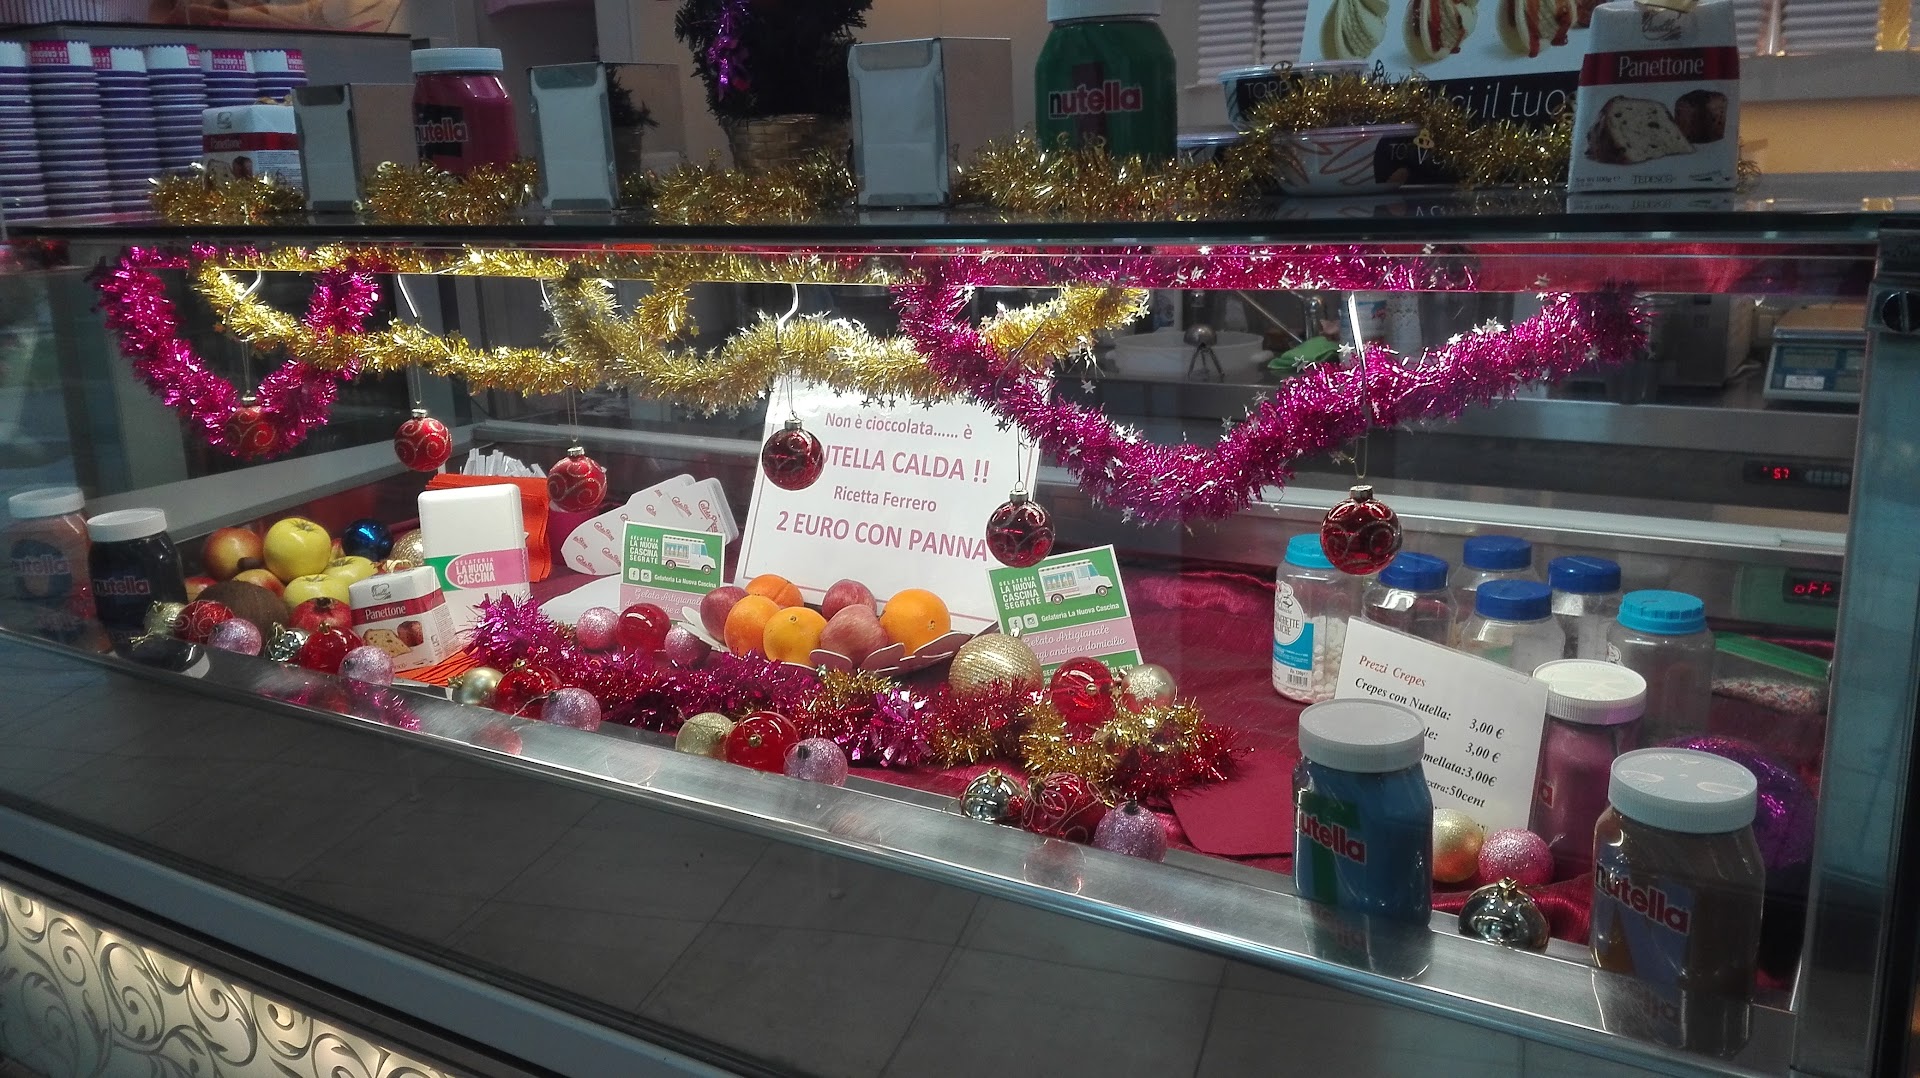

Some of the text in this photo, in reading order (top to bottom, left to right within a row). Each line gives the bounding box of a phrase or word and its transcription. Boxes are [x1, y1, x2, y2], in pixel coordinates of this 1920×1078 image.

[1618, 55, 1705, 79] Panettone
[1048, 79, 1143, 119] nutella
[1482, 82, 1500, 118] il
[1510, 85, 1567, 118] tuo
[414, 117, 469, 146] nutella
[825, 412, 852, 429] Non
[854, 414, 863, 429] è
[963, 423, 973, 440] è
[823, 444, 991, 484] UTELLA CALDA !!
[833, 485, 938, 513] Ricetta Ferrero
[630, 535, 659, 543] GELATERIA
[630, 540, 659, 551] LA NUOVA
[776, 510, 988, 563] 2 EURO CON PANNA
[455, 557, 494, 566] GELATERIA
[629, 547, 658, 558] CASCINA
[629, 555, 659, 565] SEGRATE
[456, 562, 495, 575] LA NUOVA
[457, 571, 496, 586] CASCINA
[93, 575, 151, 597] nutella
[654, 574, 717, 589] Gelateria La Nuova Cascina
[999, 575, 1036, 586] GELATERIA
[1000, 581, 1037, 594] LA NUOVA
[634, 588, 702, 606] Gelato Artigianal
[1002, 591, 1040, 603] CASCINA
[1004, 598, 1042, 611] SEGRATE
[365, 605, 406, 621] Panettone
[1041, 603, 1120, 623] Gelateria La Nuova Cascina
[1023, 624, 1111, 648] Gelato Artigianale
[1050, 645, 1077, 657] anche
[1086, 636, 1126, 650] domicilio
[1358, 655, 1427, 688] Prezzi Crepes
[1355, 677, 1505, 740] Crepes con Nutella: 3,00 €
[1423, 726, 1502, 764] le: 3,00 €
[1296, 808, 1367, 865] utella
[1595, 859, 1692, 935] nutella
